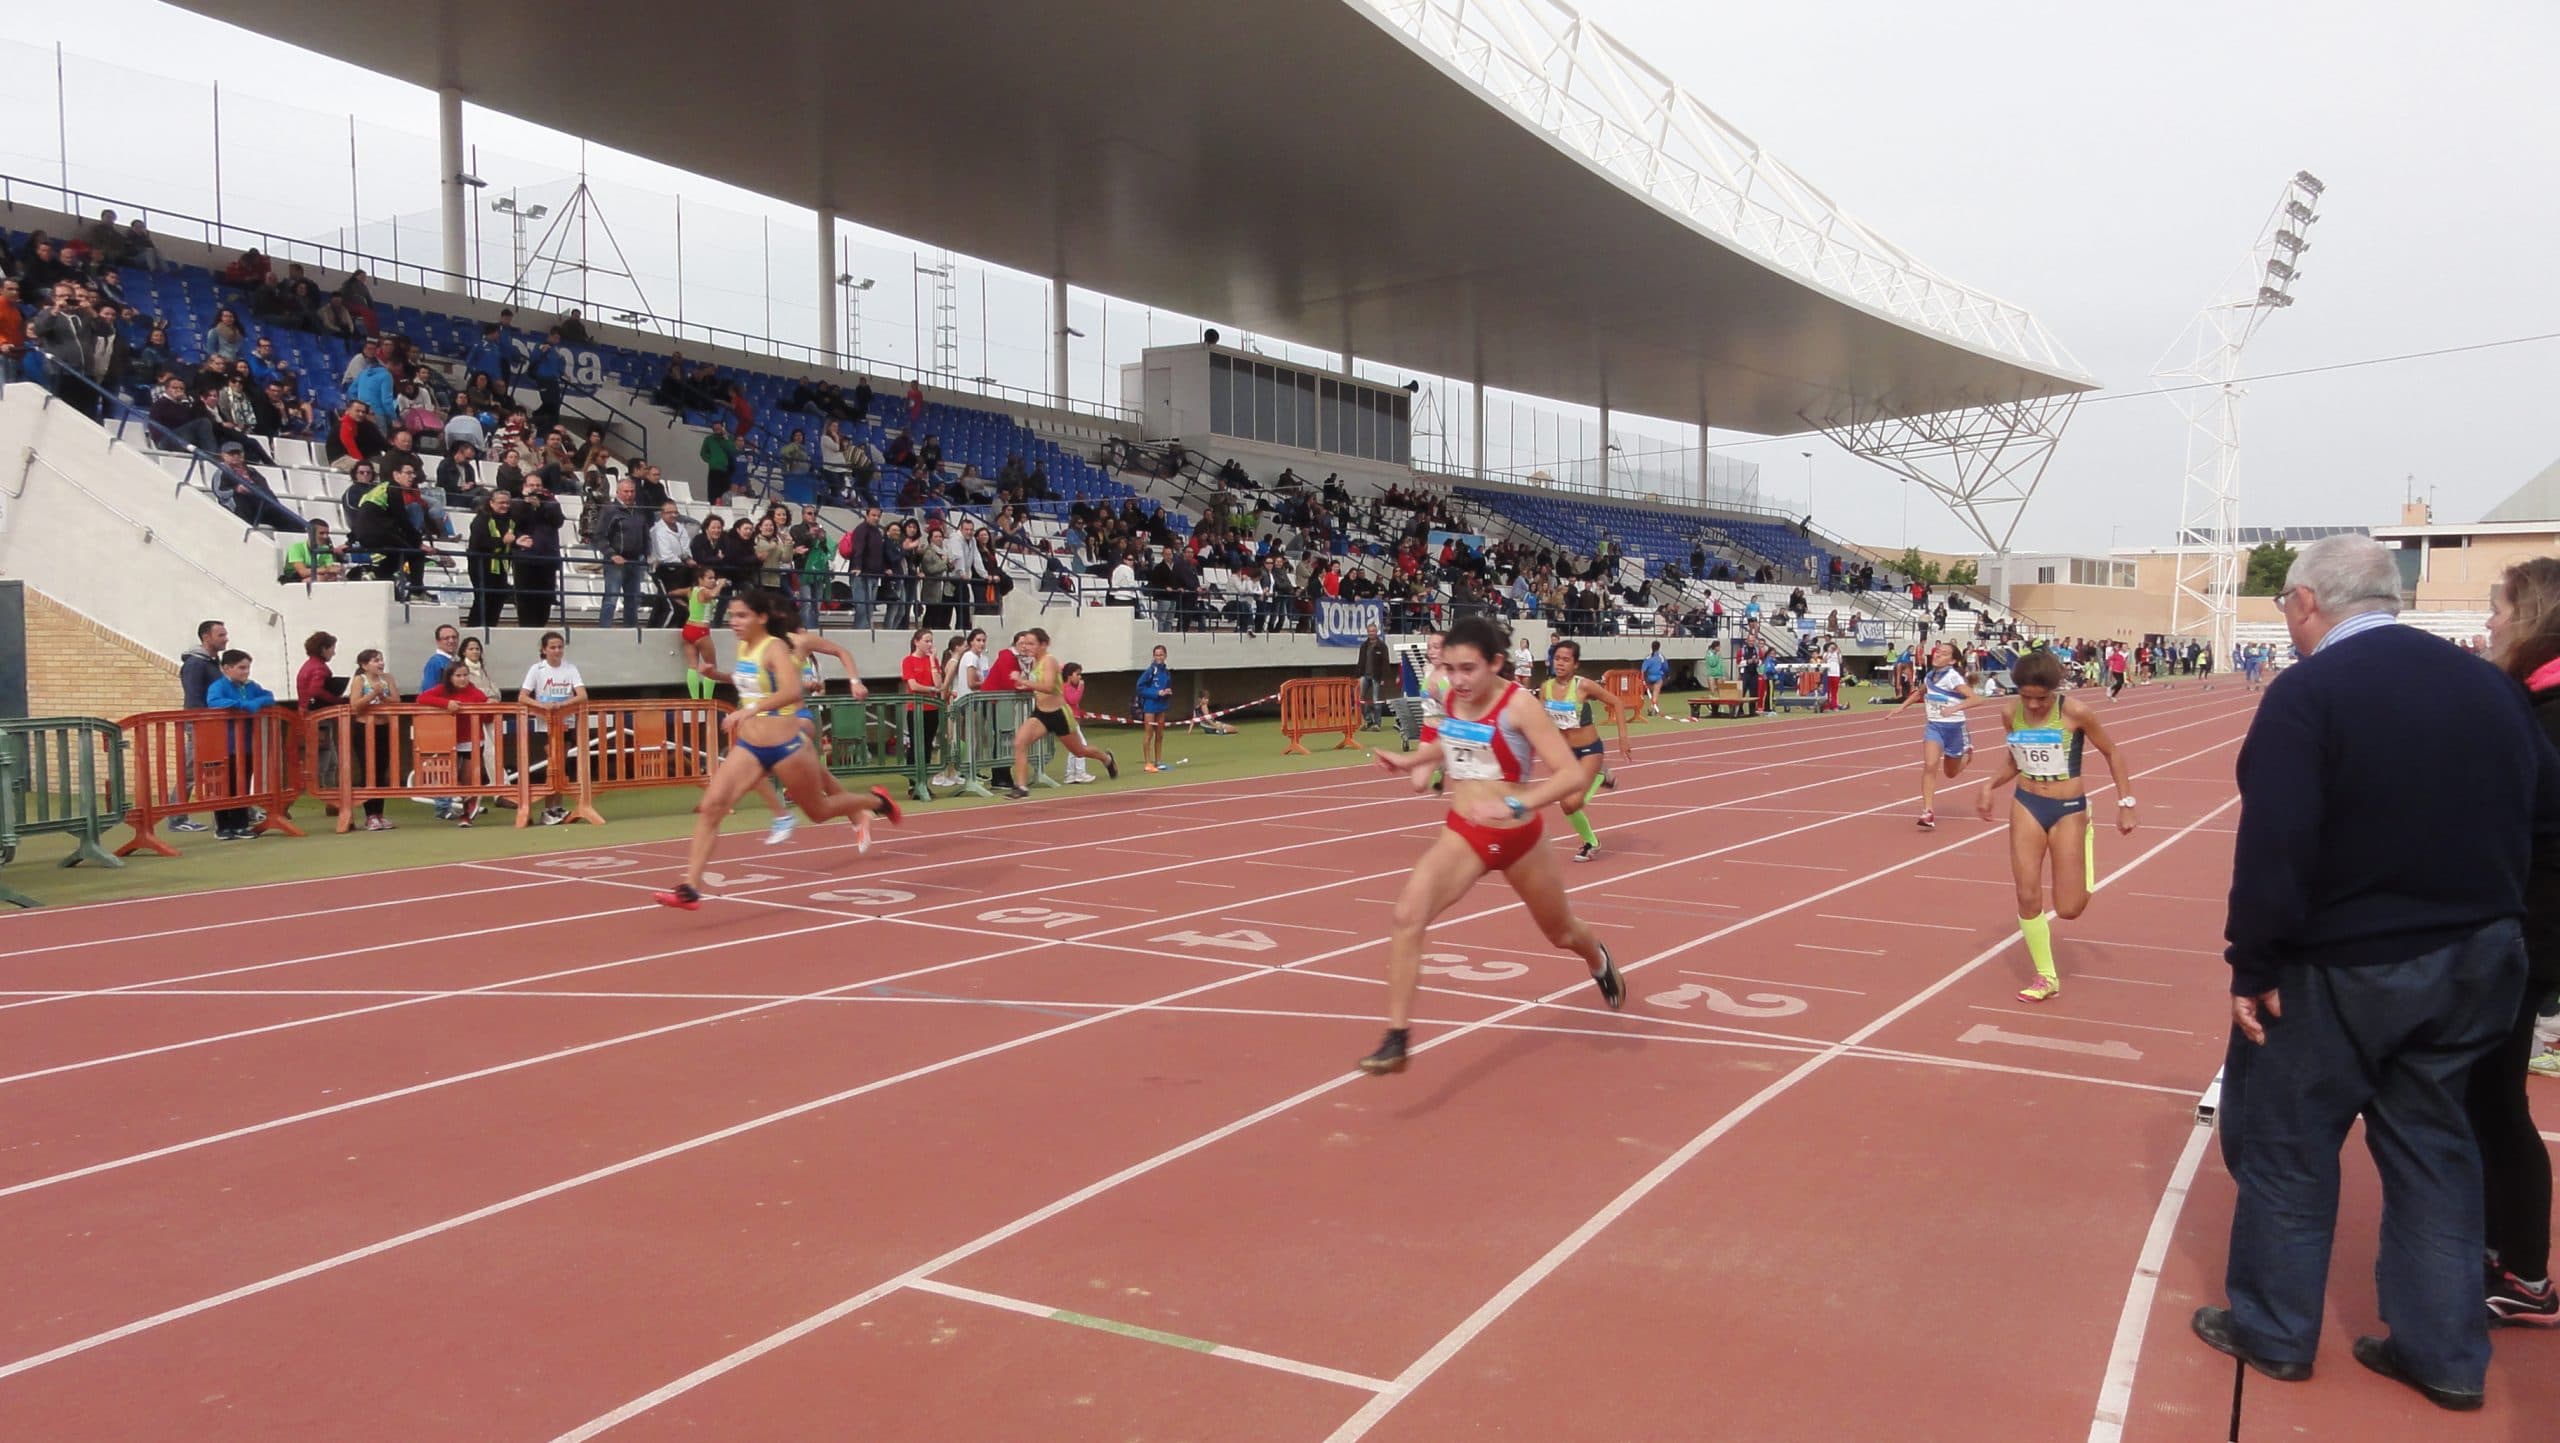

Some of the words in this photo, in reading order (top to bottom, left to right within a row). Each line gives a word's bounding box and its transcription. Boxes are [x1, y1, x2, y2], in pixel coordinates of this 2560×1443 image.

[2023, 750, 2049, 762] 166
[809, 888, 917, 905] 6
[976, 907, 1099, 928] 5
[1146, 930, 1278, 950] 4
[1420, 953, 1529, 981] 3
[1645, 984, 1808, 1017] 2
[1956, 1024, 2144, 1061] 1
